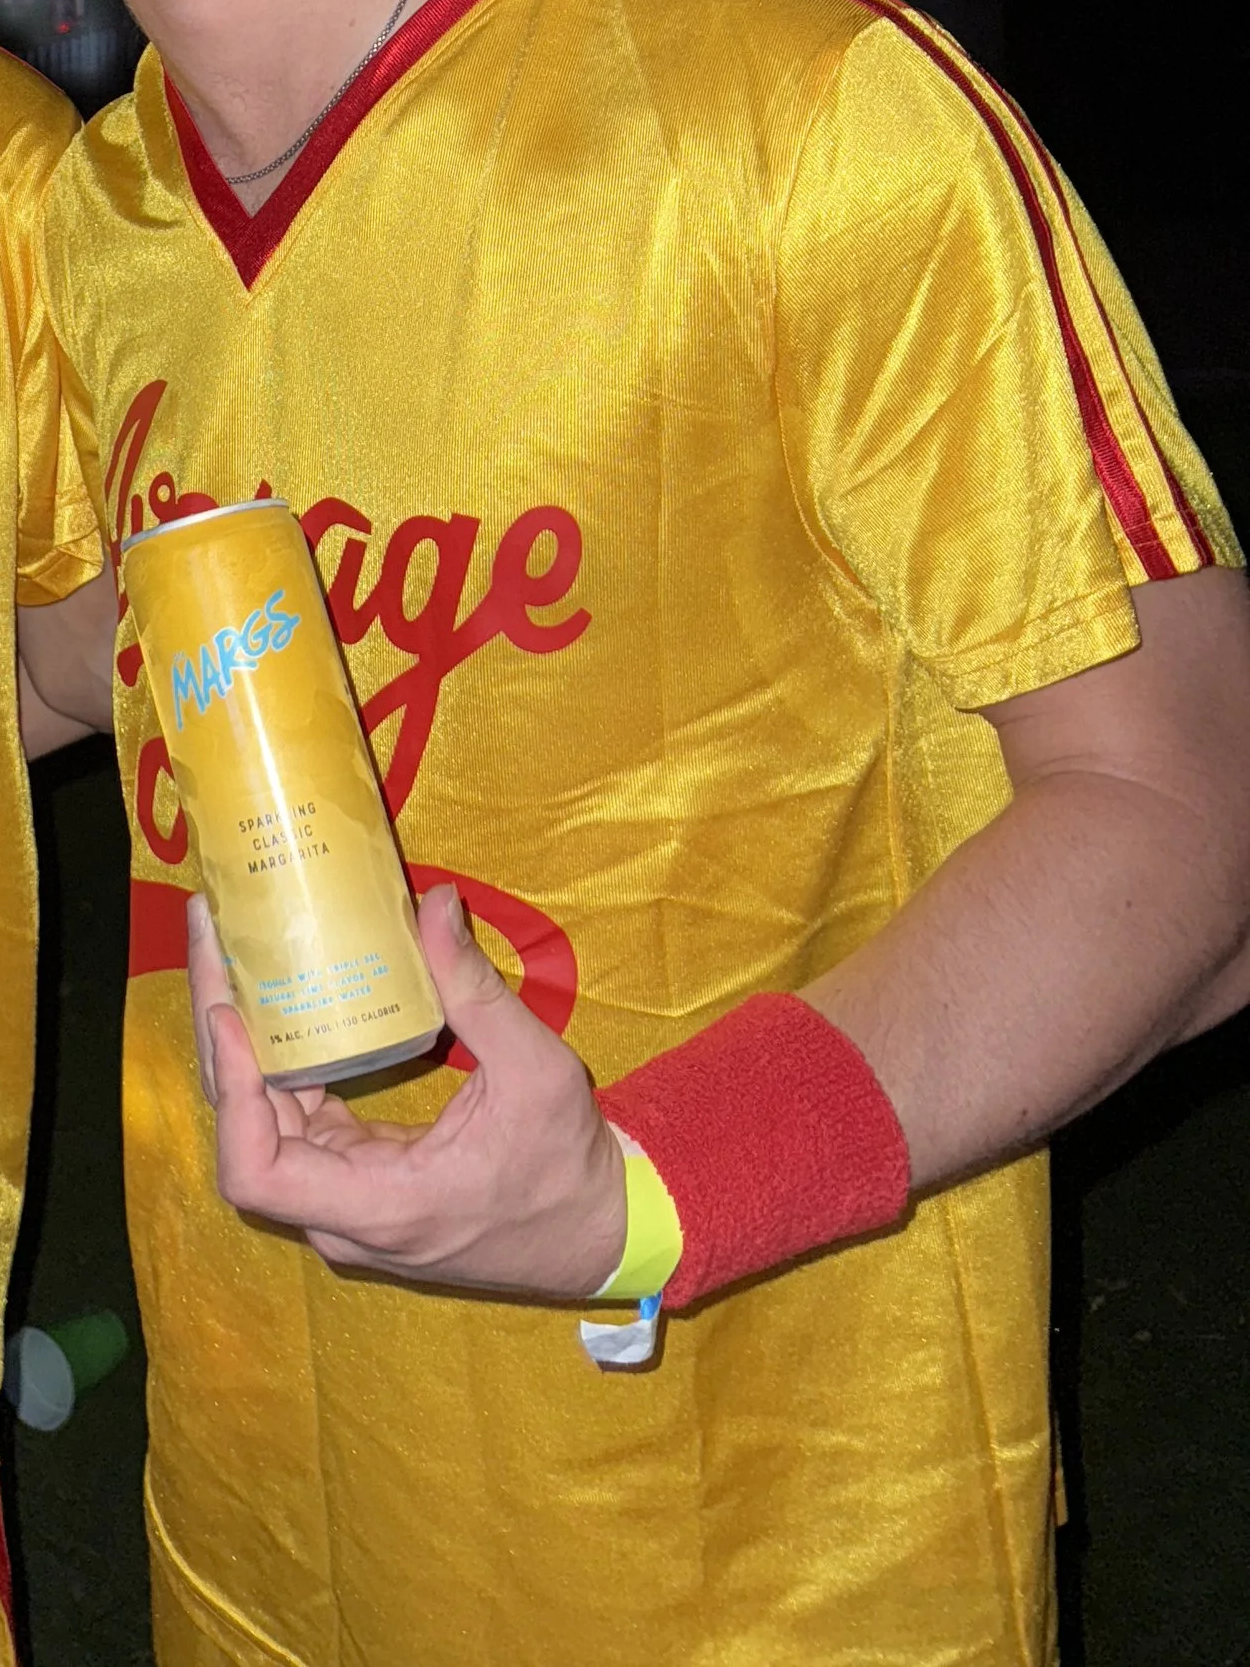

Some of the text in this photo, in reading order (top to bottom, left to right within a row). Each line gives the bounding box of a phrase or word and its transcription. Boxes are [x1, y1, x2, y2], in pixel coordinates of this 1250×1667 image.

[104, 379, 593, 823] Aage
[172, 587, 302, 733] MARGS
[238, 801, 317, 833] SPARKING
[247, 841, 330, 874] MARGARITA
[361, 1003, 401, 1023] CALORIES
